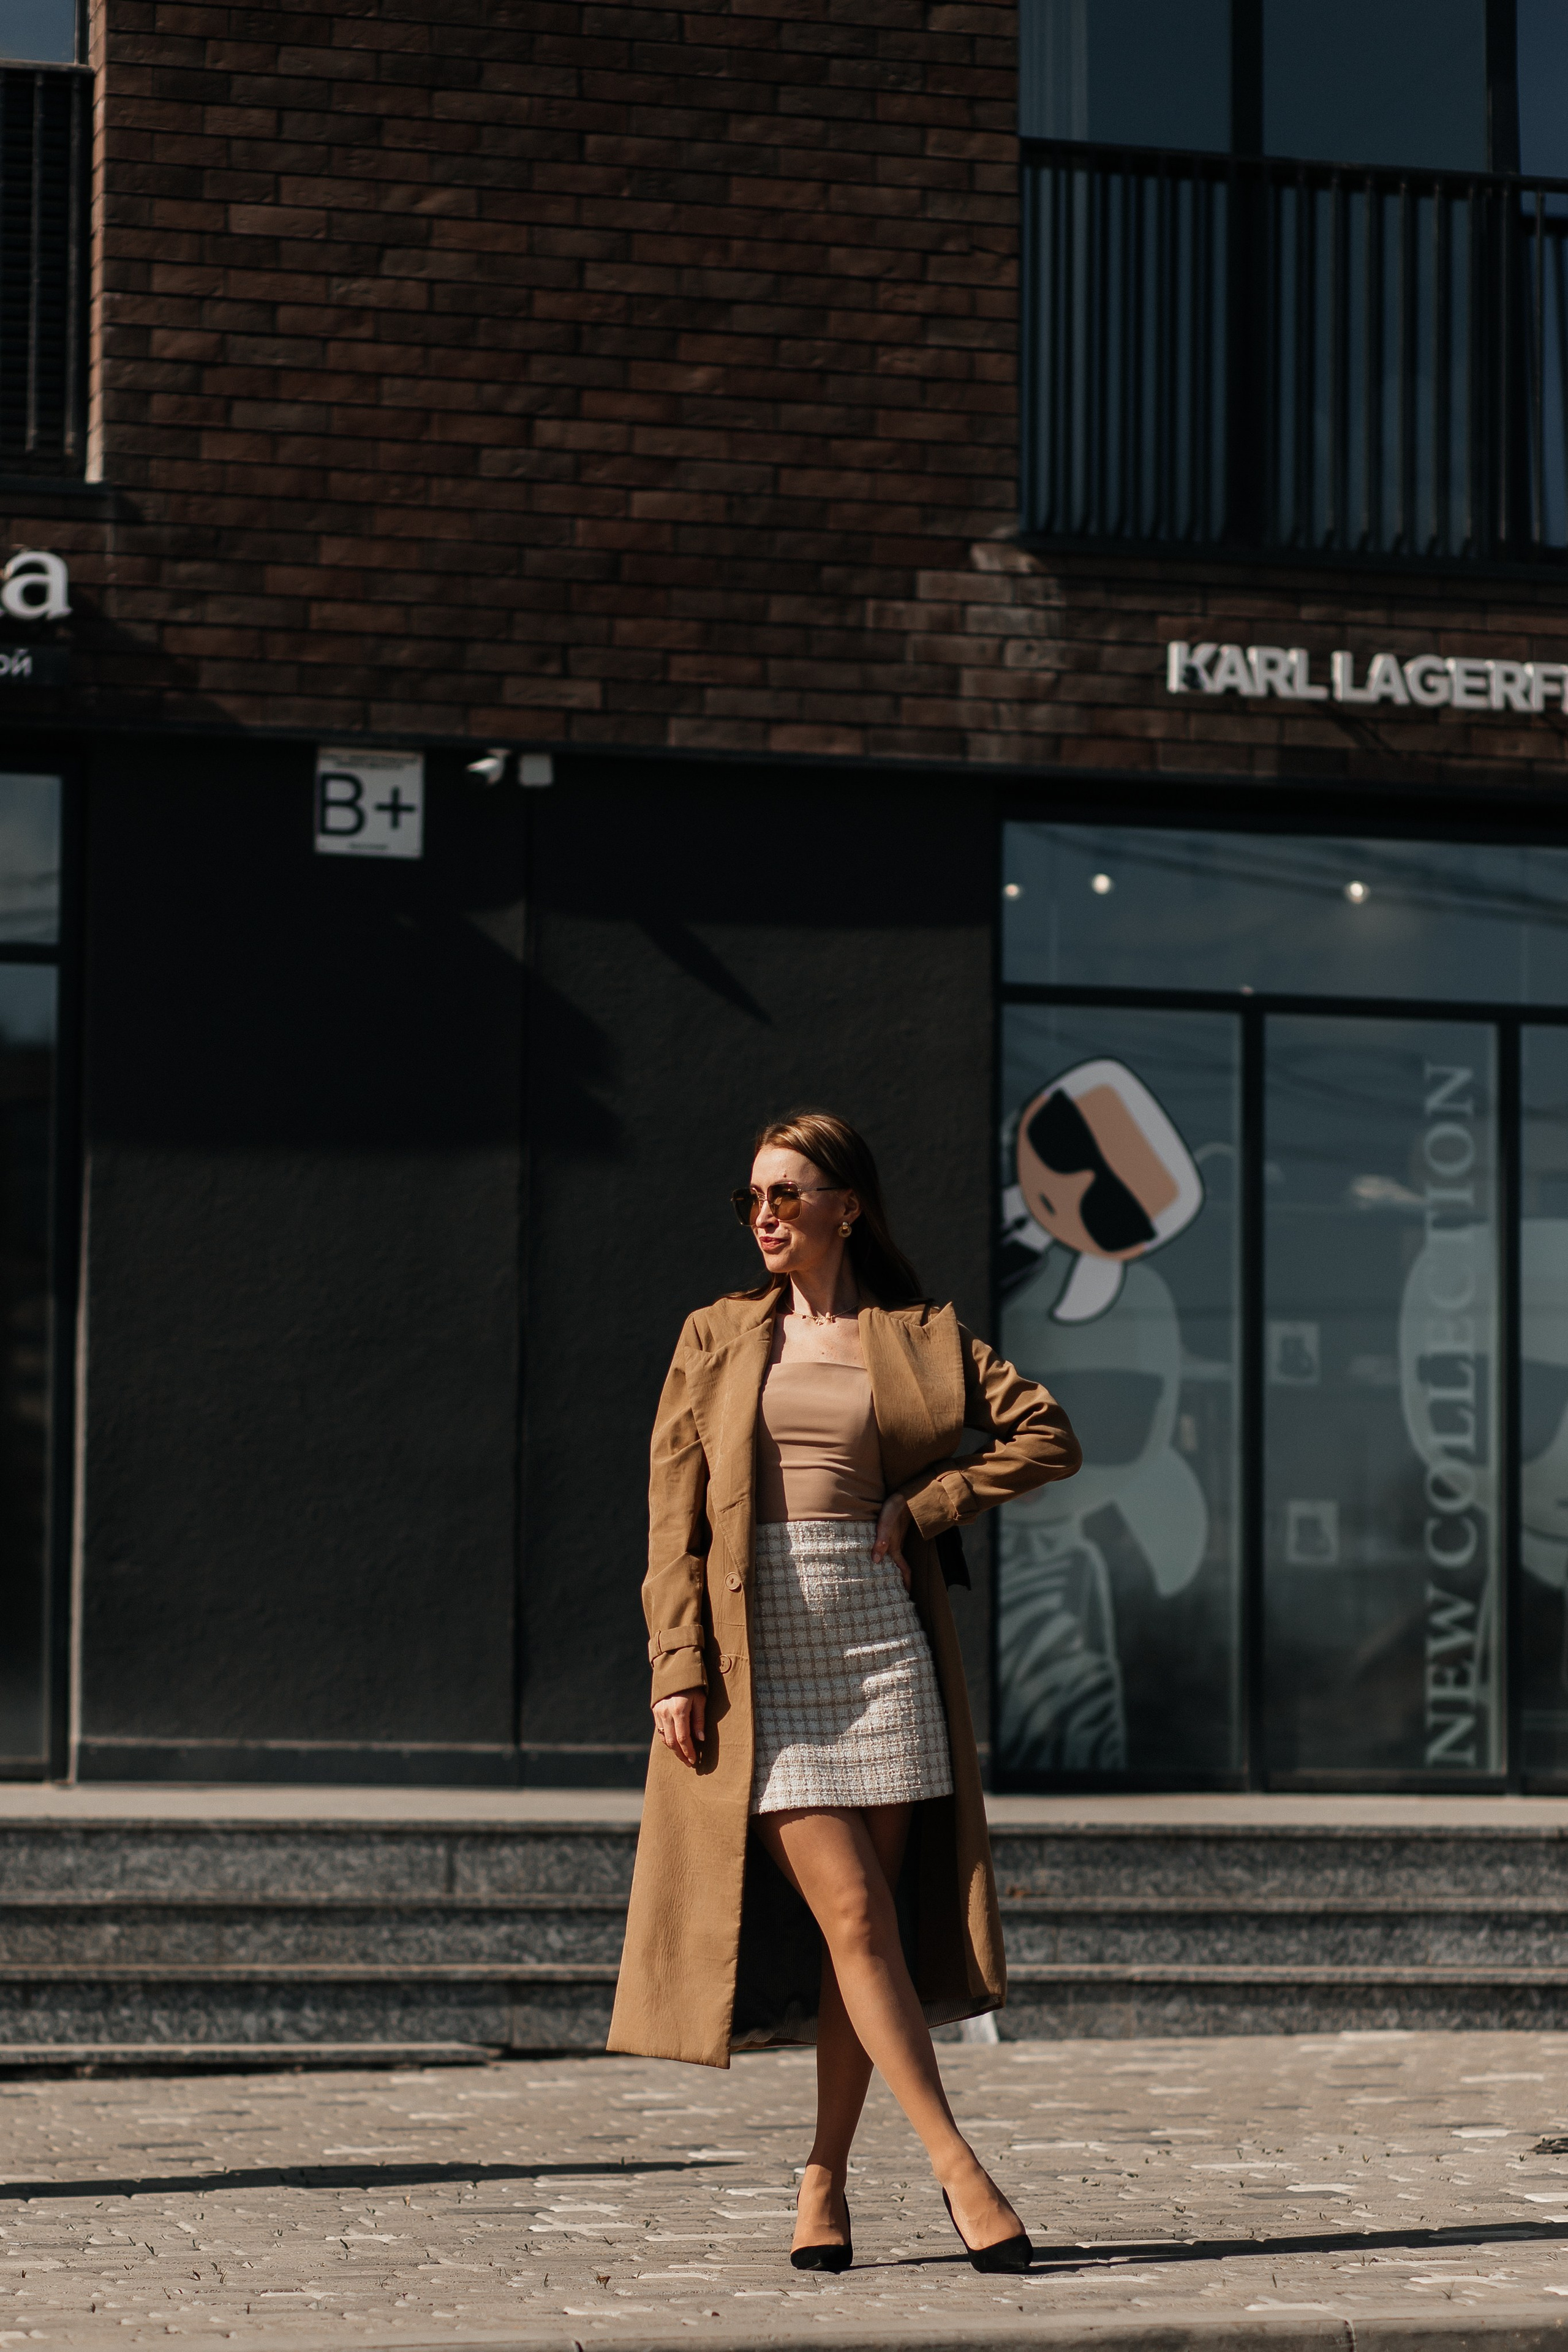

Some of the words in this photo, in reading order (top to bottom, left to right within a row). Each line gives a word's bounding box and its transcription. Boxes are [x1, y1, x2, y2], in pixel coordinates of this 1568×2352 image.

[1167, 641, 1329, 699] KARL
[1331, 650, 1568, 715] LAGERF
[320, 772, 415, 835] B+
[1425, 1063, 1477, 1568] COLLECTION
[1425, 1584, 1477, 1765] NEW
